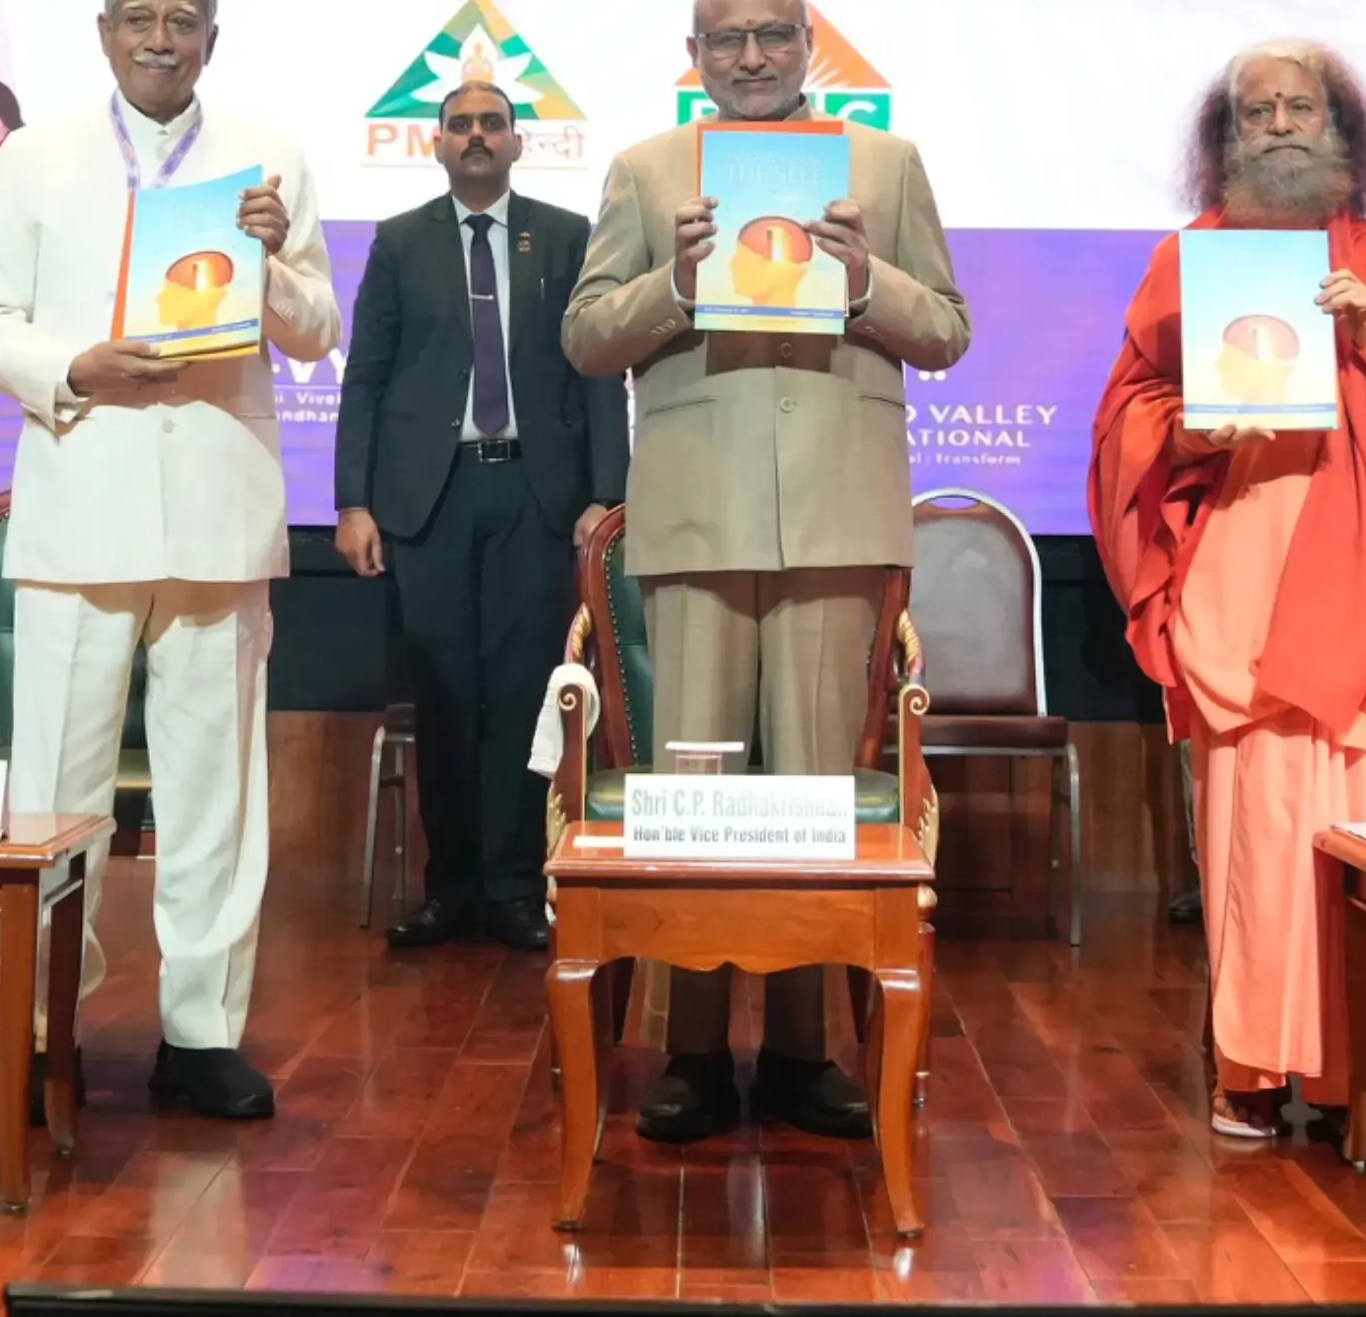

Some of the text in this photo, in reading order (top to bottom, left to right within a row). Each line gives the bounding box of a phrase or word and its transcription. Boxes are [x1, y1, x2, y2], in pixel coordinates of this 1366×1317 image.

[367, 123, 441, 157] PM
[928, 403, 1059, 425] VALLEY
[935, 452, 1022, 465] Transform
[631, 788, 667, 818] Shri
[690, 826, 720, 843] Vice
[723, 825, 790, 844] President
[794, 827, 808, 844] of
[811, 827, 847, 844] India
